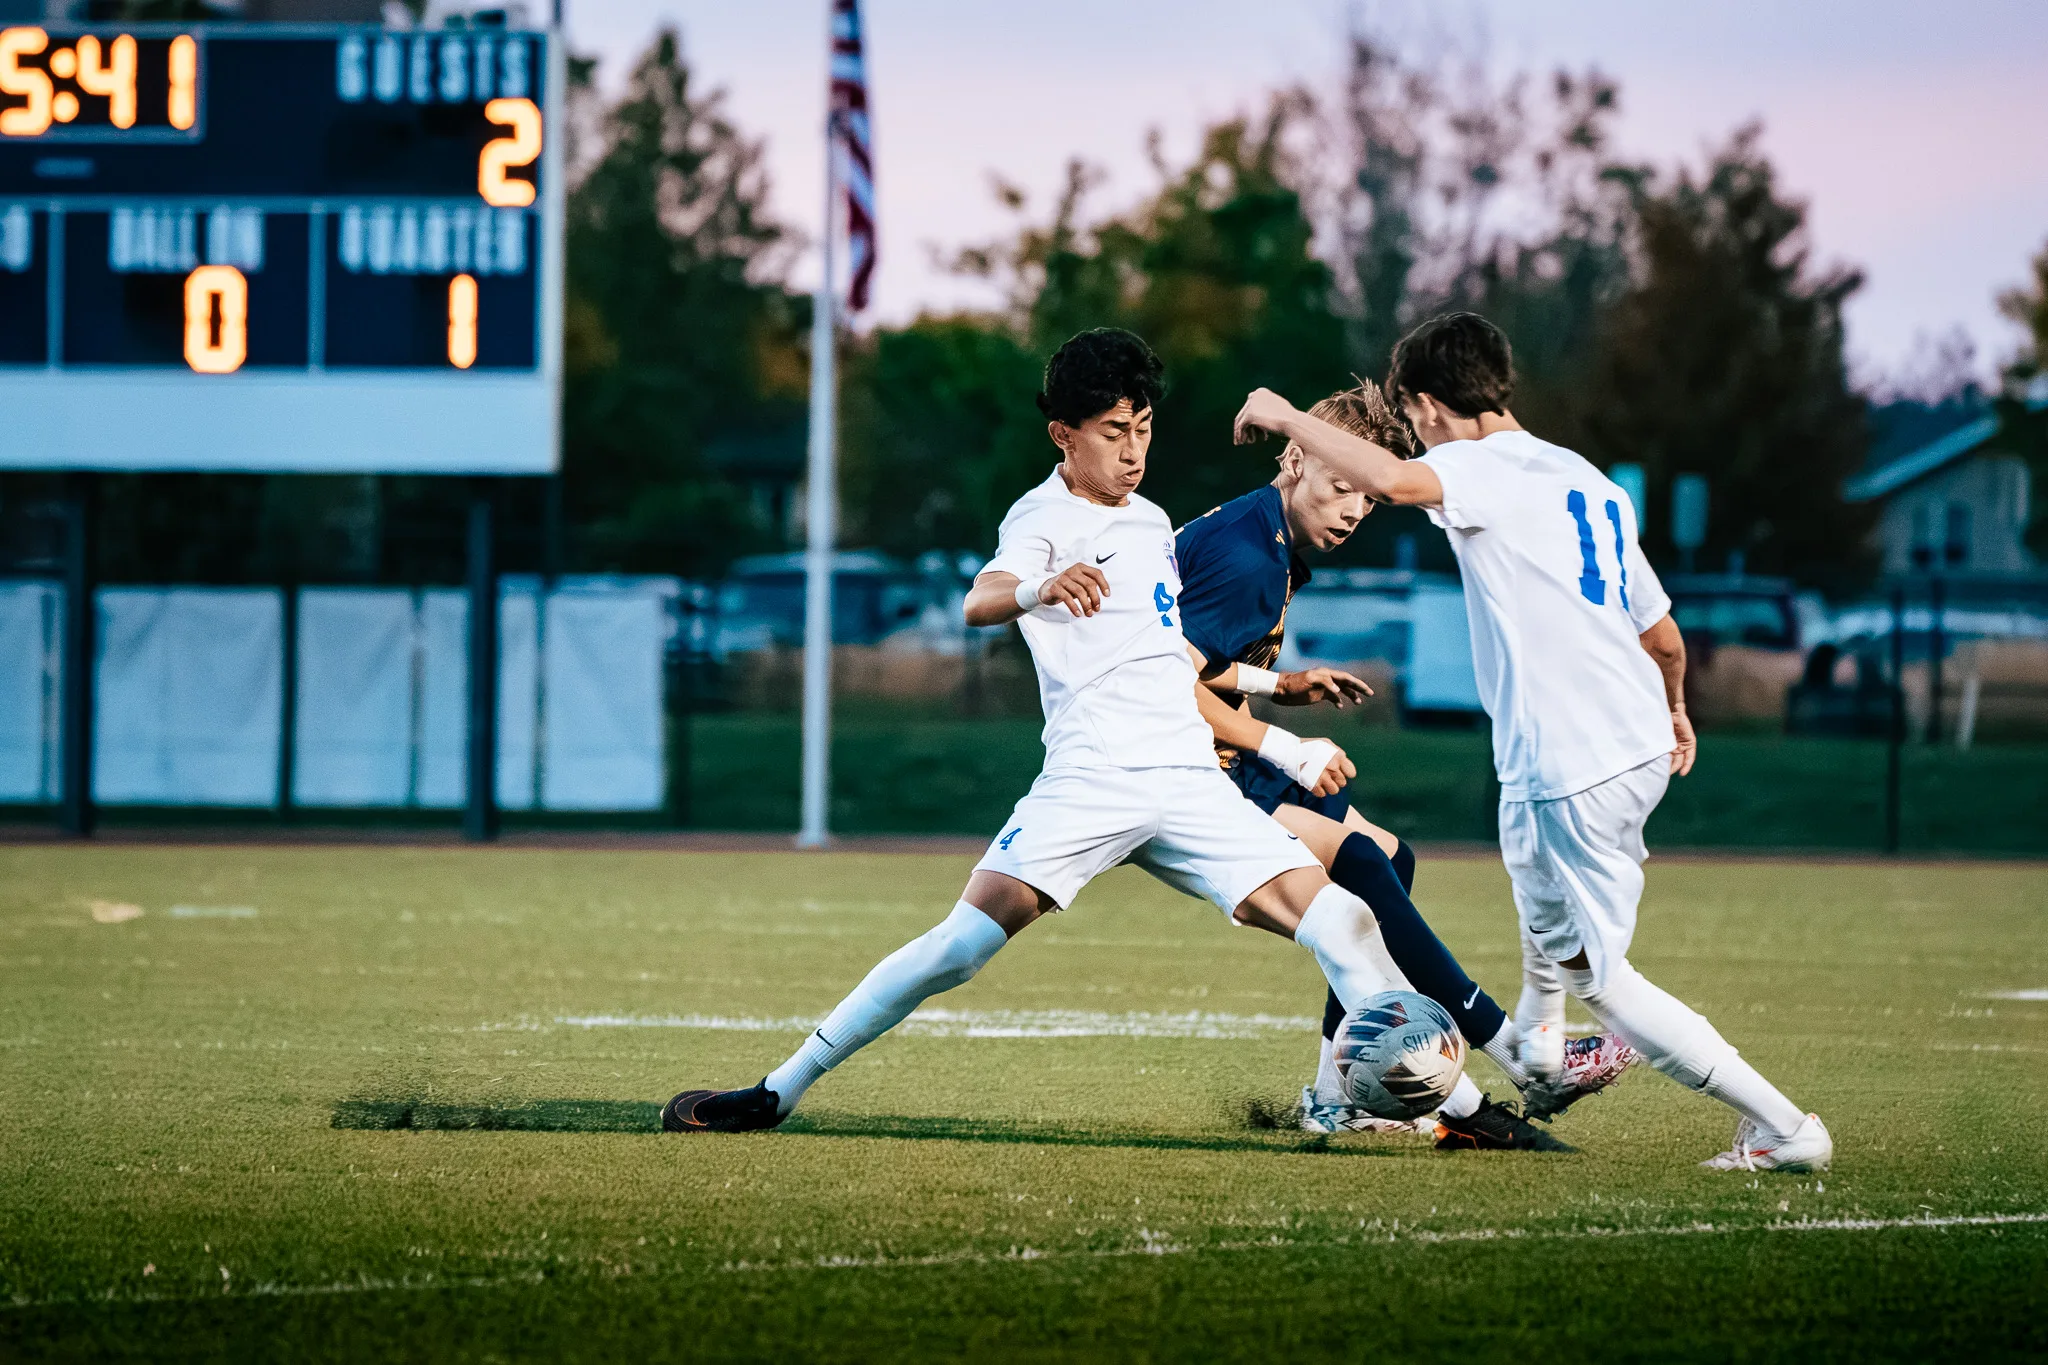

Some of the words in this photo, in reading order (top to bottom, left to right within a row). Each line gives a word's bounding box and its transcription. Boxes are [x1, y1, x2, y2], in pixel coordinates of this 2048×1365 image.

[0, 27, 196, 136] 5:41
[478, 97, 543, 206] 2
[184, 265, 247, 373] 0
[448, 274, 478, 368] 1
[1567, 489, 1629, 612] 11
[999, 828, 1022, 850] 4
